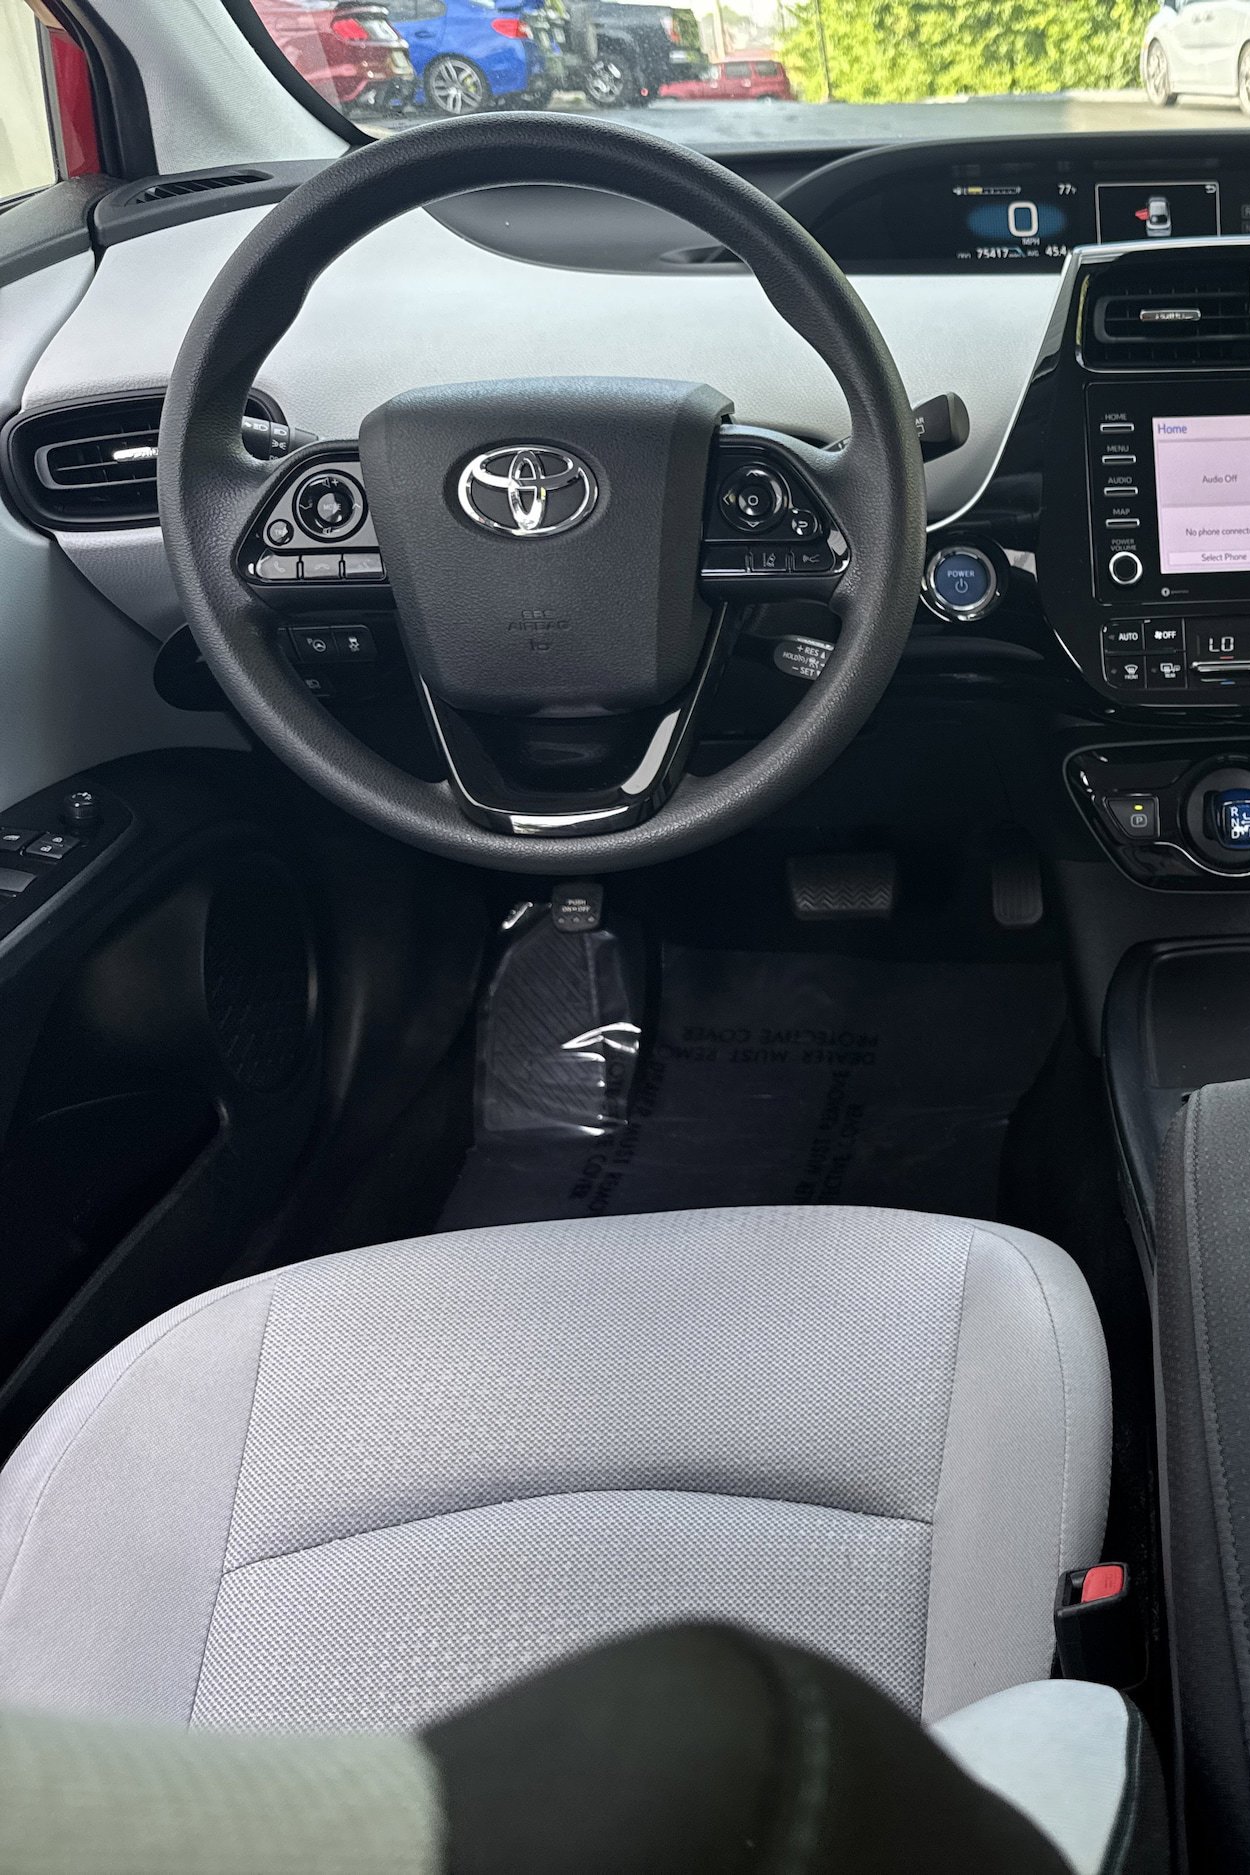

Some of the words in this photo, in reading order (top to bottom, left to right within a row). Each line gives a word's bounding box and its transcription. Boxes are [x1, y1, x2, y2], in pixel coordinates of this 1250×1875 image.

[1007, 201, 1039, 238] 0
[1105, 413, 1128, 421] HOME
[1157, 423, 1188, 435] Home
[1106, 445, 1130, 453] MENU
[1107, 476, 1133, 485] AUDIO
[1202, 475, 1224, 484] Audio
[1225, 474, 1238, 484] Off
[1112, 507, 1131, 516] MAP
[1185, 528, 1197, 537] No
[1198, 528, 1221, 538] phone
[1201, 553, 1224, 562] Select
[1225, 552, 1248, 562] Phone
[947, 570, 975, 578] POWER
[1118, 632, 1139, 641] AUTO
[1162, 630, 1177, 640] OFF
[799, 666, 815, 677] SET
[1230, 806, 1239, 817] R
[1230, 817, 1240, 828] N
